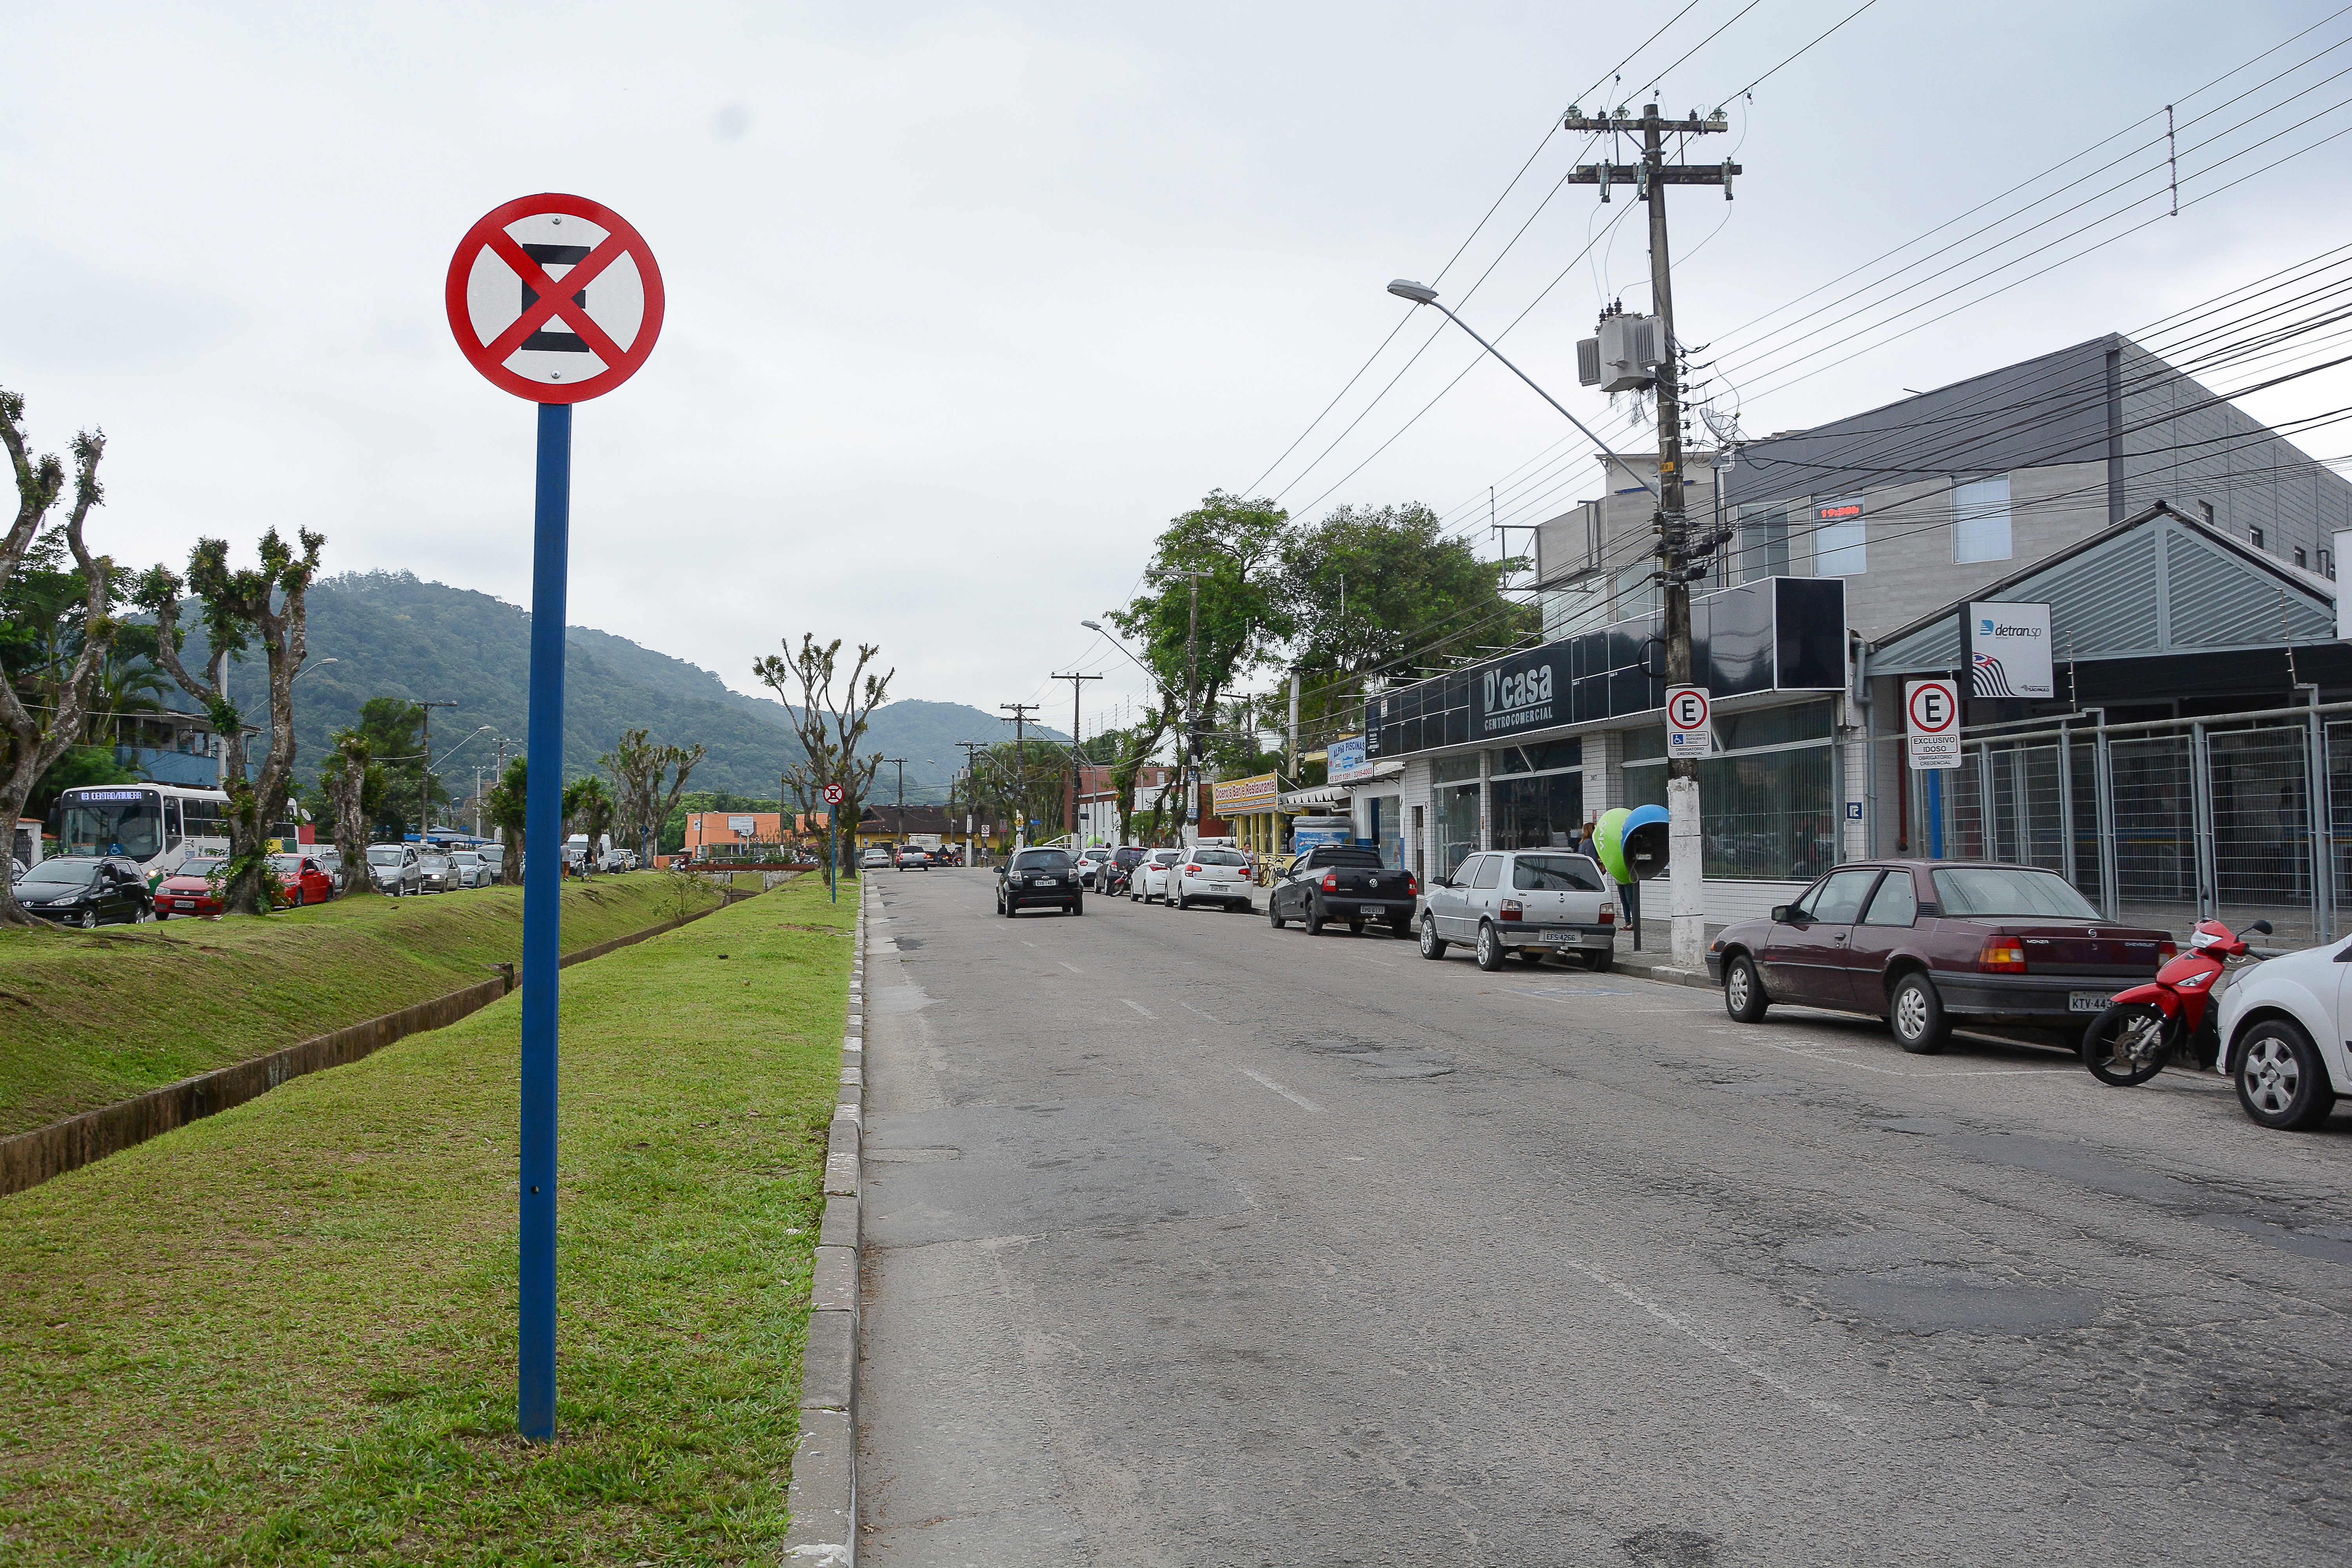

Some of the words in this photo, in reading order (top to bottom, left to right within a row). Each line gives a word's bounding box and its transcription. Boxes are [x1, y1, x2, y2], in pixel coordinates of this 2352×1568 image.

[1821, 505, 1859, 518] 19:30h
[1995, 624, 2042, 640] detran.sp
[1484, 665, 1552, 713] D'casa
[1485, 715, 1510, 731] CENTRO
[1511, 706, 1552, 725] COMERCIAL
[1682, 699, 1696, 722] E
[1925, 694, 1942, 722] E
[1346, 741, 1365, 751] PISCINAS
[1354, 767, 1372, 778] 3316-4003
[1216, 785, 1232, 801] Cicero's
[1232, 784, 1241, 799] Bar
[1242, 785, 1245, 798] e
[1245, 777, 1275, 797] Restaurante
[1598, 820, 1608, 850] vivo
